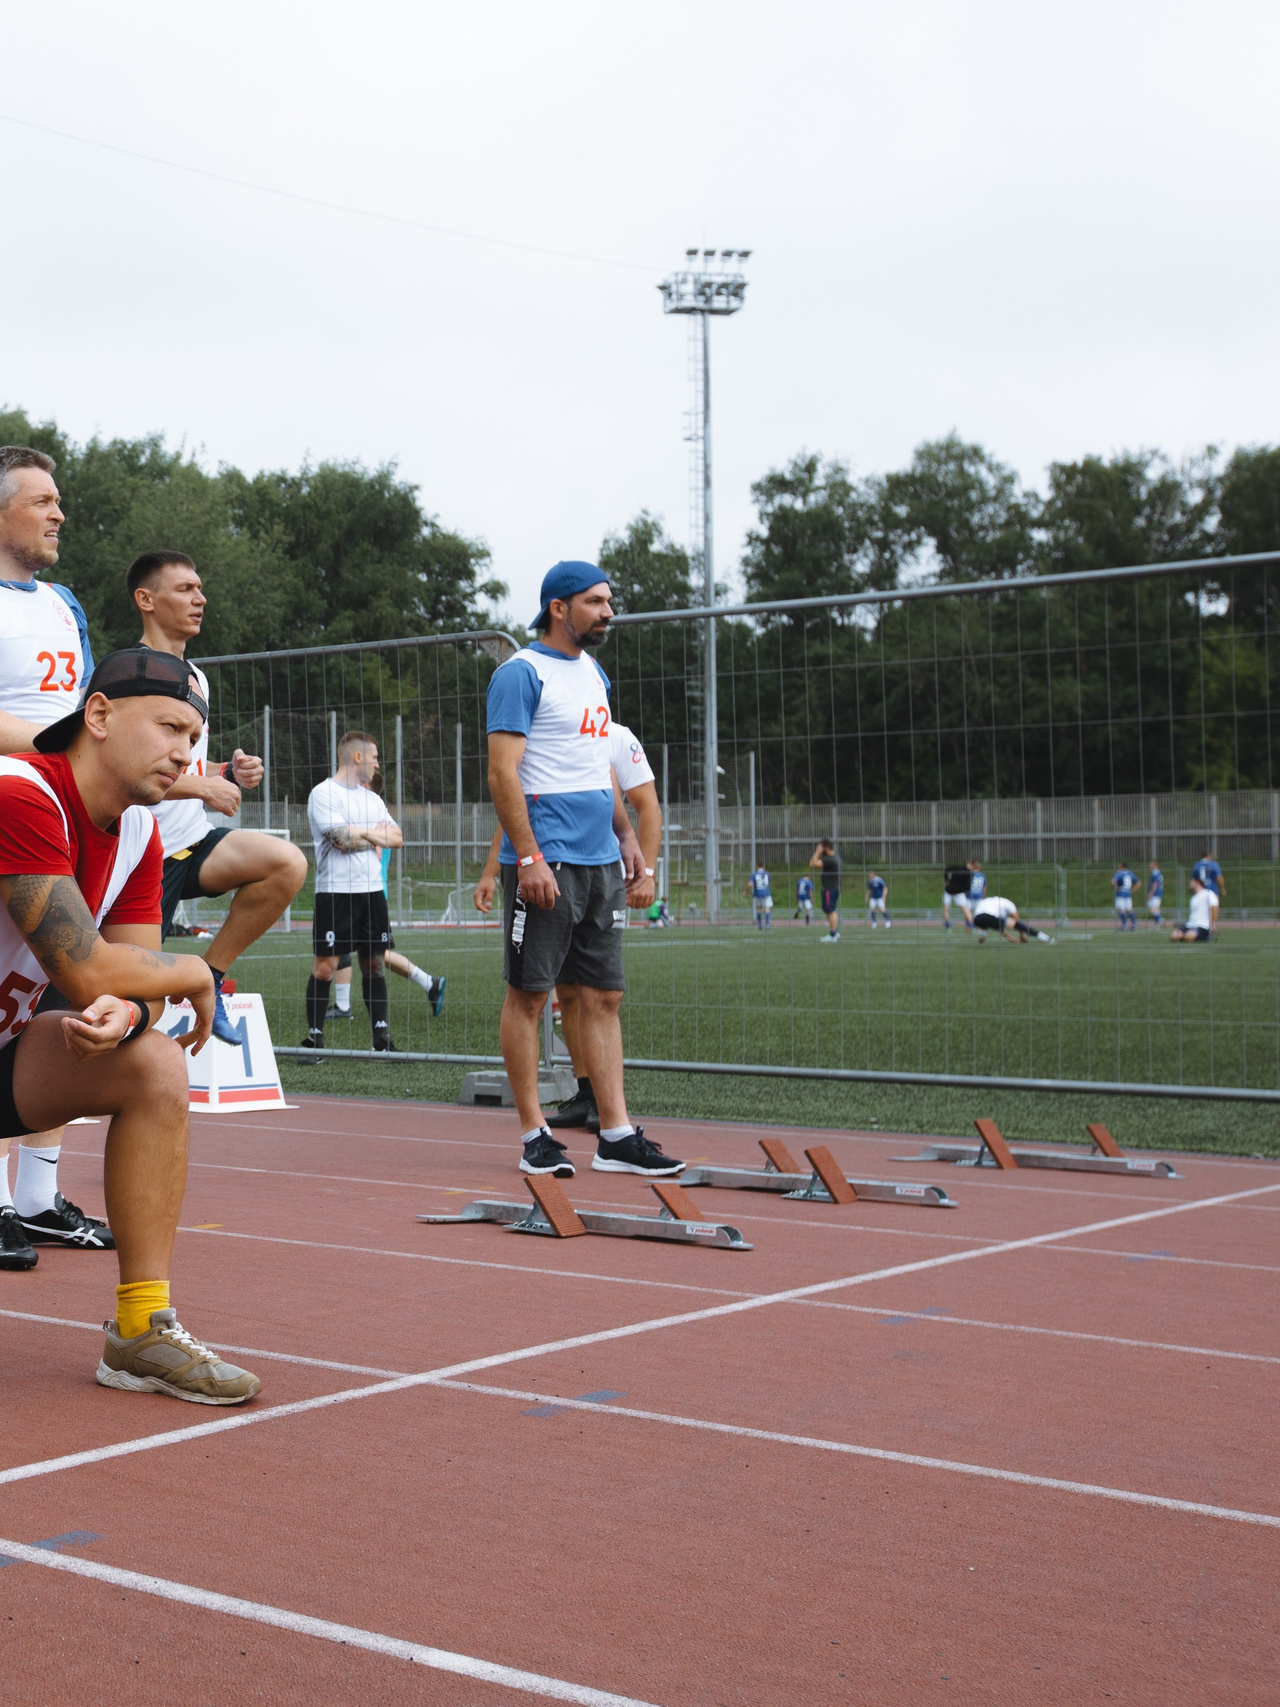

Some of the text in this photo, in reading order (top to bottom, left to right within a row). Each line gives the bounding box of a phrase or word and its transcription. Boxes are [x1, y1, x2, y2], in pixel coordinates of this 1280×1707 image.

[36, 650, 77, 692] 23
[580, 706, 609, 738] 42
[325, 930, 336, 948] 9
[232, 1002, 254, 1010] polanik
